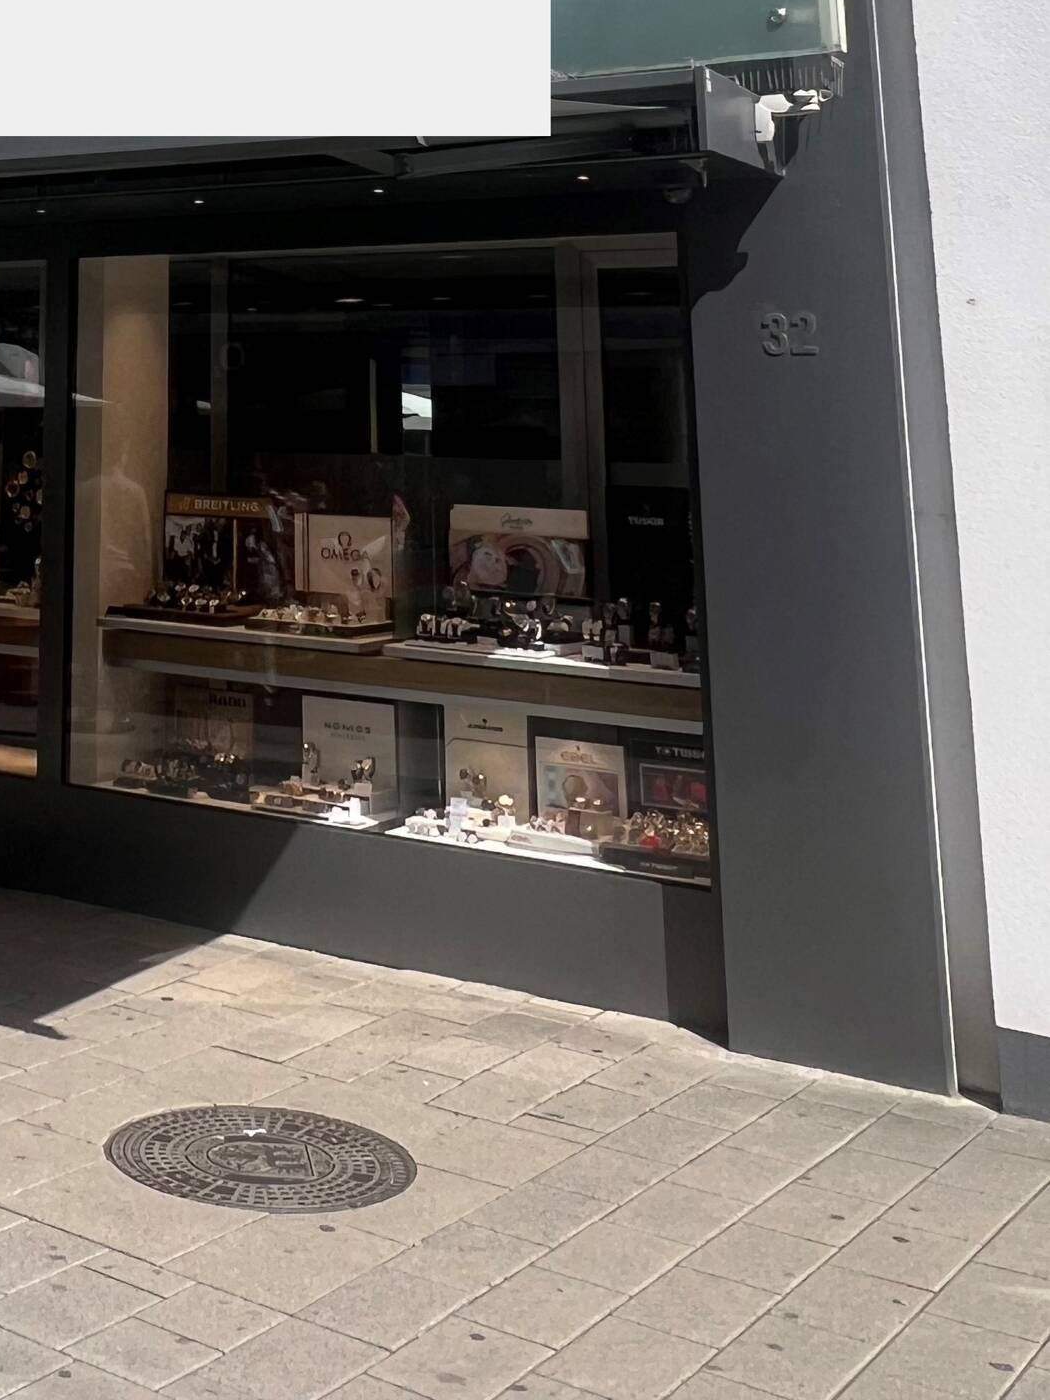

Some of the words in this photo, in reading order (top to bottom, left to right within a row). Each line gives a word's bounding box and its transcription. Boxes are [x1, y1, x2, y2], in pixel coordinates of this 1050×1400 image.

[760, 312, 819, 357] 32
[193, 497, 262, 513] BREITLING
[320, 546, 371, 561] OMEGA
[323, 721, 372, 734] NOMOS
